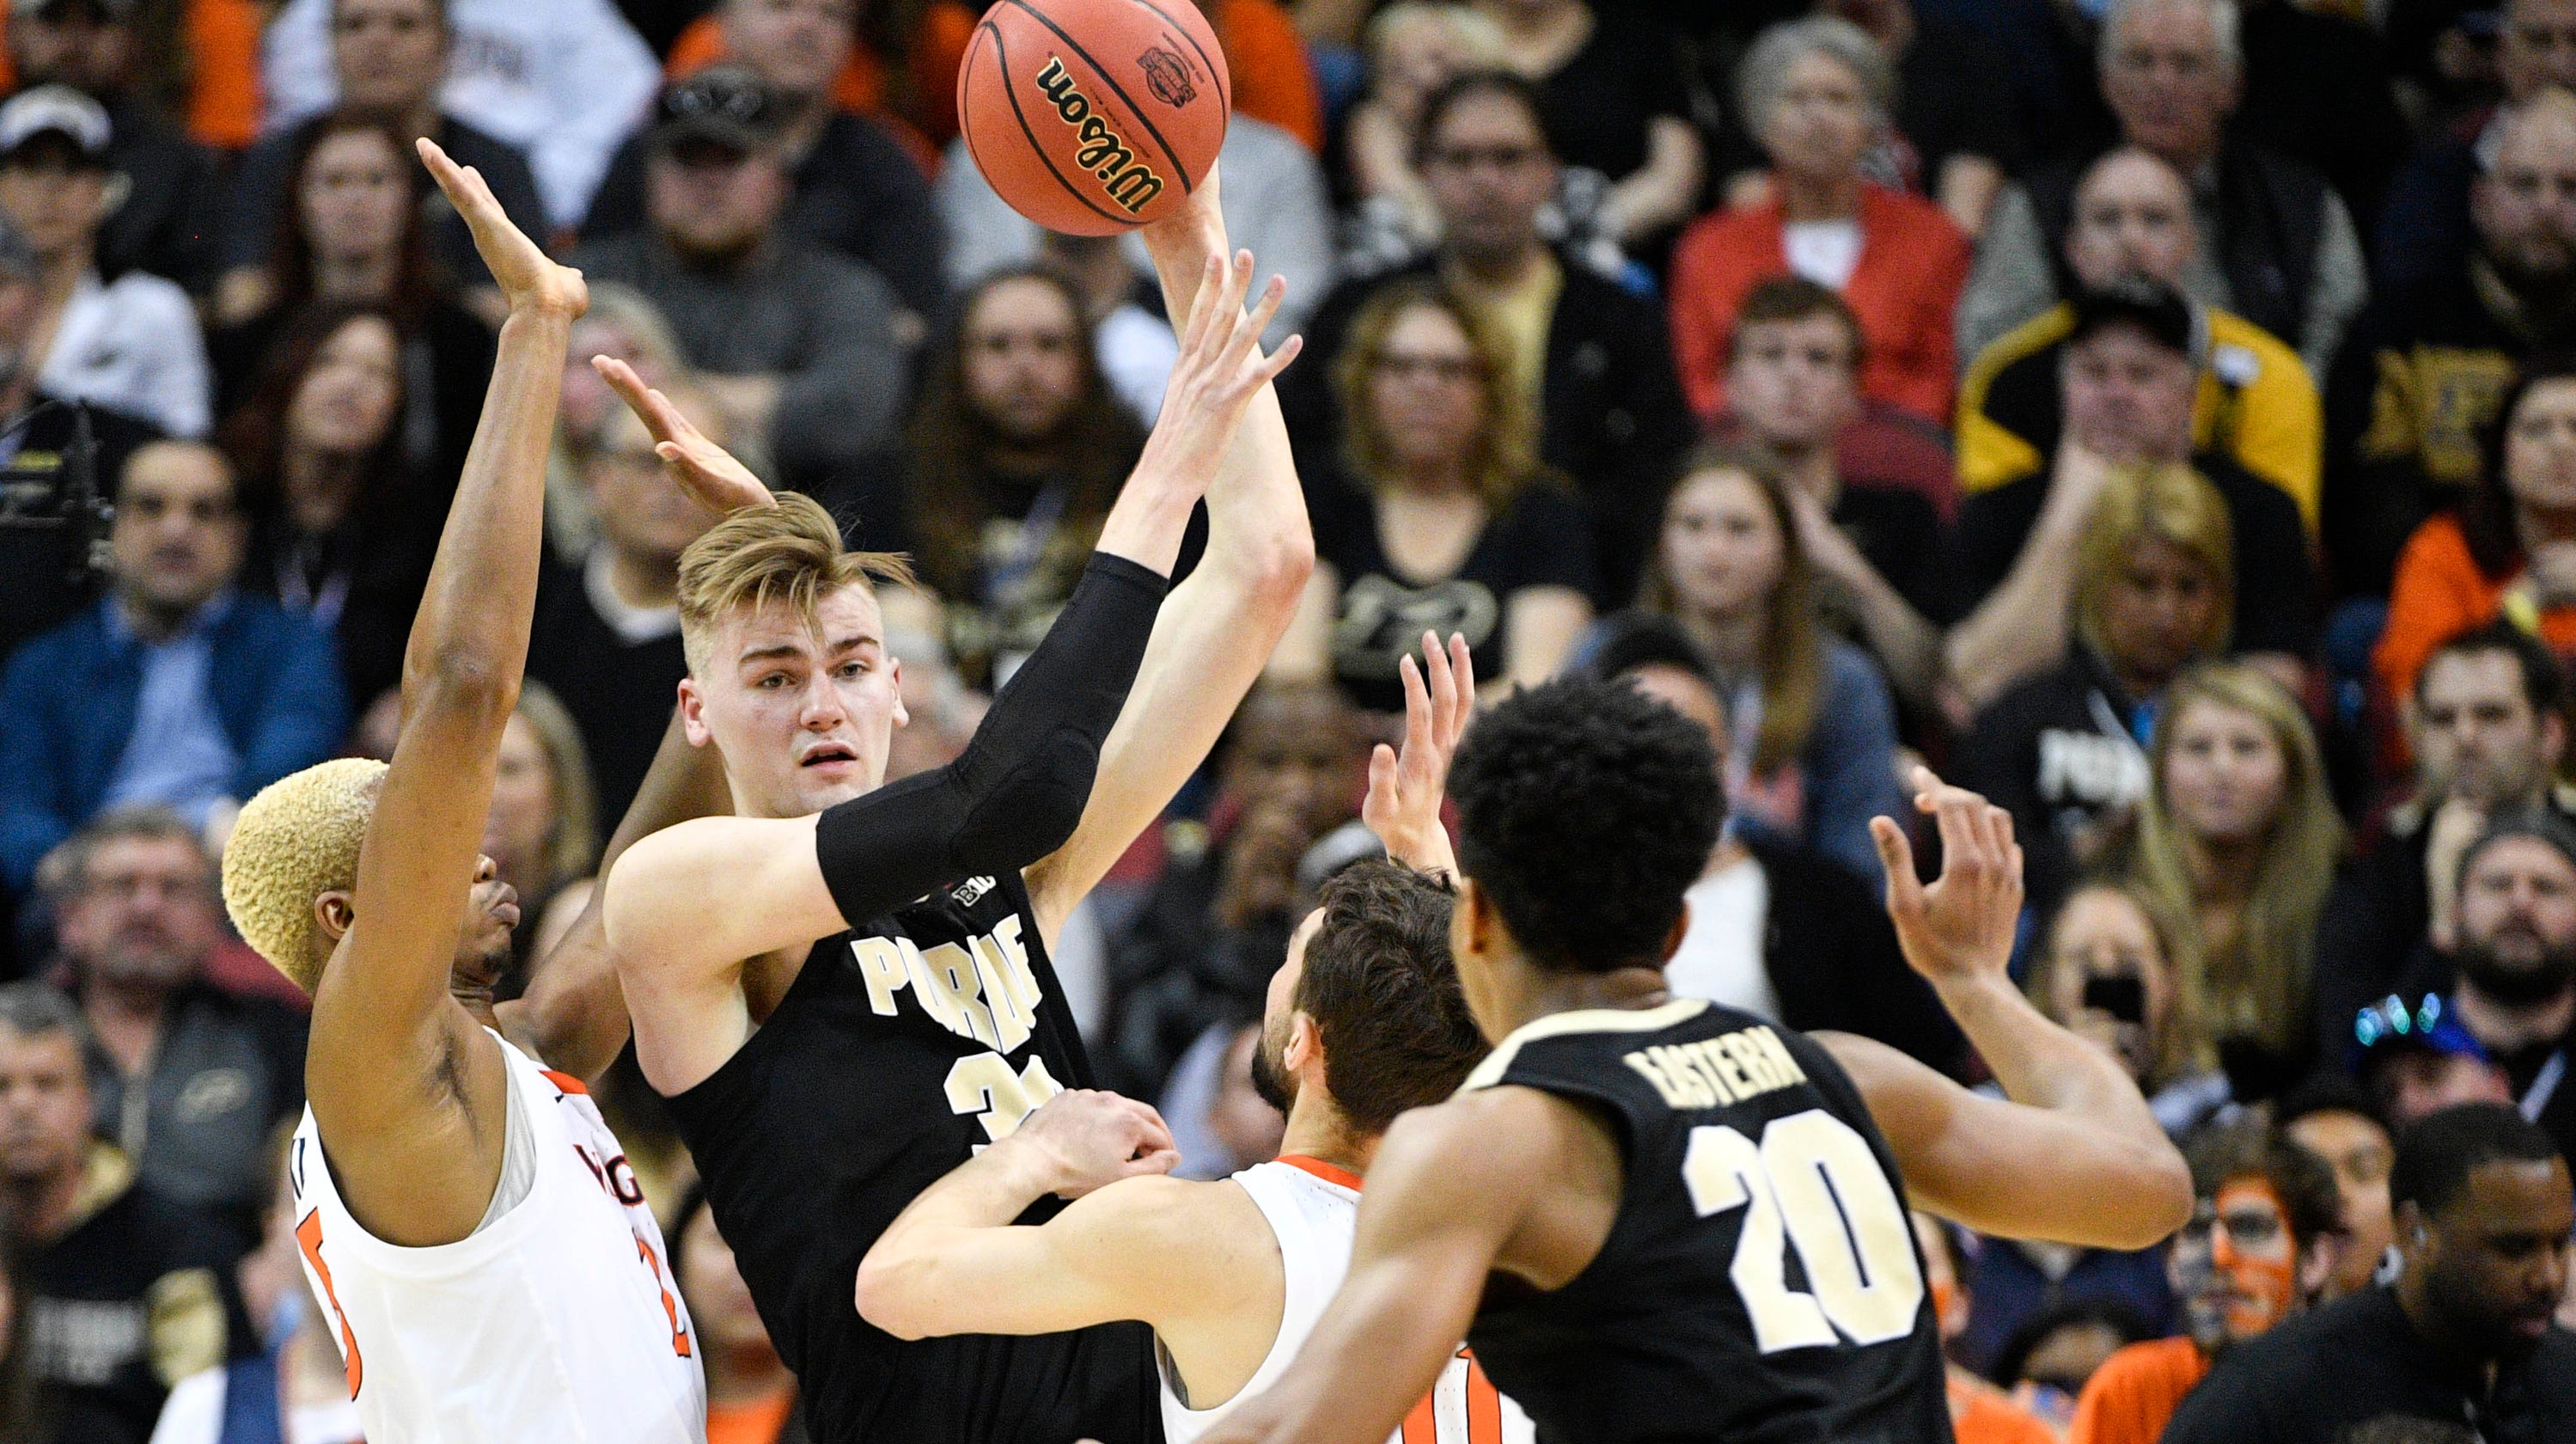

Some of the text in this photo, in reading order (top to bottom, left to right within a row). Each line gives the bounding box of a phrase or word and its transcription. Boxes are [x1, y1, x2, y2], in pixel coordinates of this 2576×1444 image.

[1036, 57, 1164, 214] Wilson
[1622, 1025, 1808, 1108] EASTERN
[1682, 1108, 1925, 1355] 20
